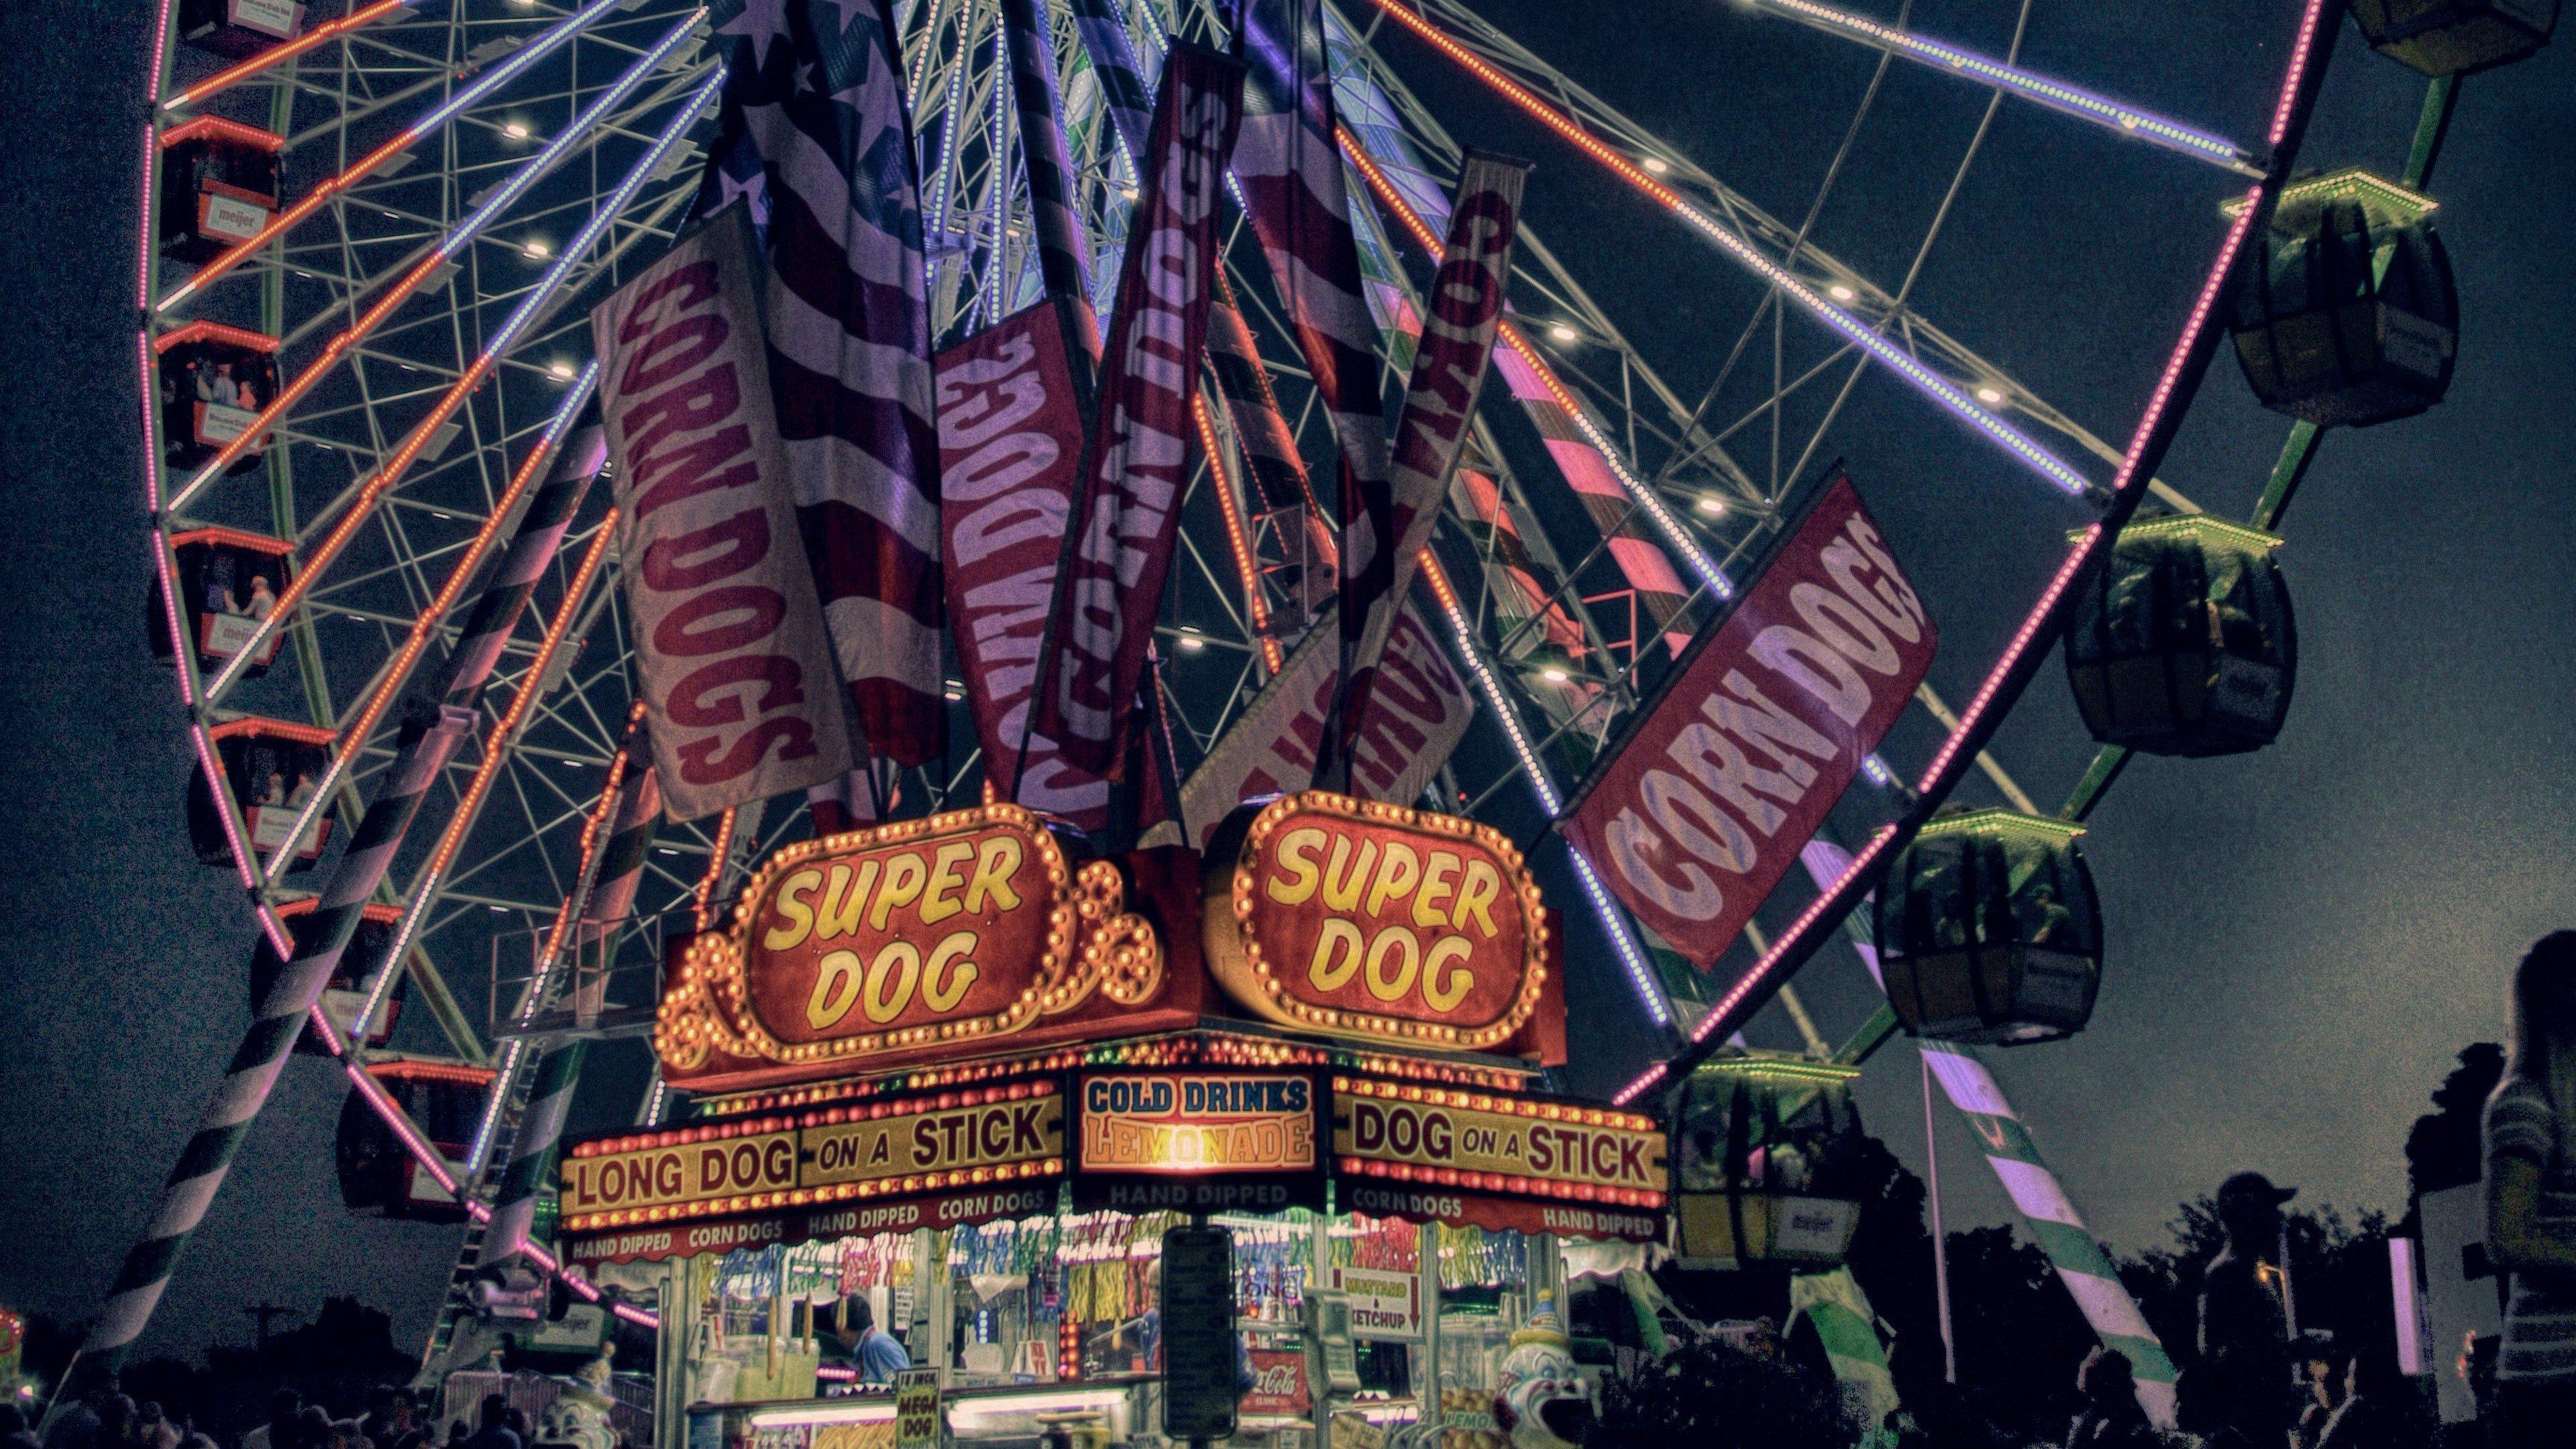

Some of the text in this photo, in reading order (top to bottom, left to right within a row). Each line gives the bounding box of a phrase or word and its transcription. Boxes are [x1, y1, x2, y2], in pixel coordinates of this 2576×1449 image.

[1059, 82, 1227, 740] CORN DOGS
[619, 259, 820, 786] CORN DOGS
[1605, 511, 1926, 922] CORN DOGS
[765, 836, 1021, 951] SUPER
[1266, 826, 1501, 940] SUPER
[806, 931, 978, 1029] DOG
[1307, 916, 1474, 1013] DOG
[1087, 1079, 1308, 1113] COLD DRINKS
[578, 1105, 1044, 1205] LONG DOG ON A STICK
[1082, 1114, 1311, 1166] LEMONADE
[1354, 1102, 1650, 1182] DOG ON A STICK
[573, 1189, 1044, 1258] HAND DIPPED CORN DOGS HAND DIPPED CORN DOGS
[1110, 1185, 1287, 1205] HAND DIPPED
[1352, 1187, 1654, 1237] CORN DOGS HAND DIPPED
[1352, 1309, 1405, 1328] ETCHUP
[898, 1396, 937, 1415] MEGA
[904, 1417, 932, 1437] DOG
